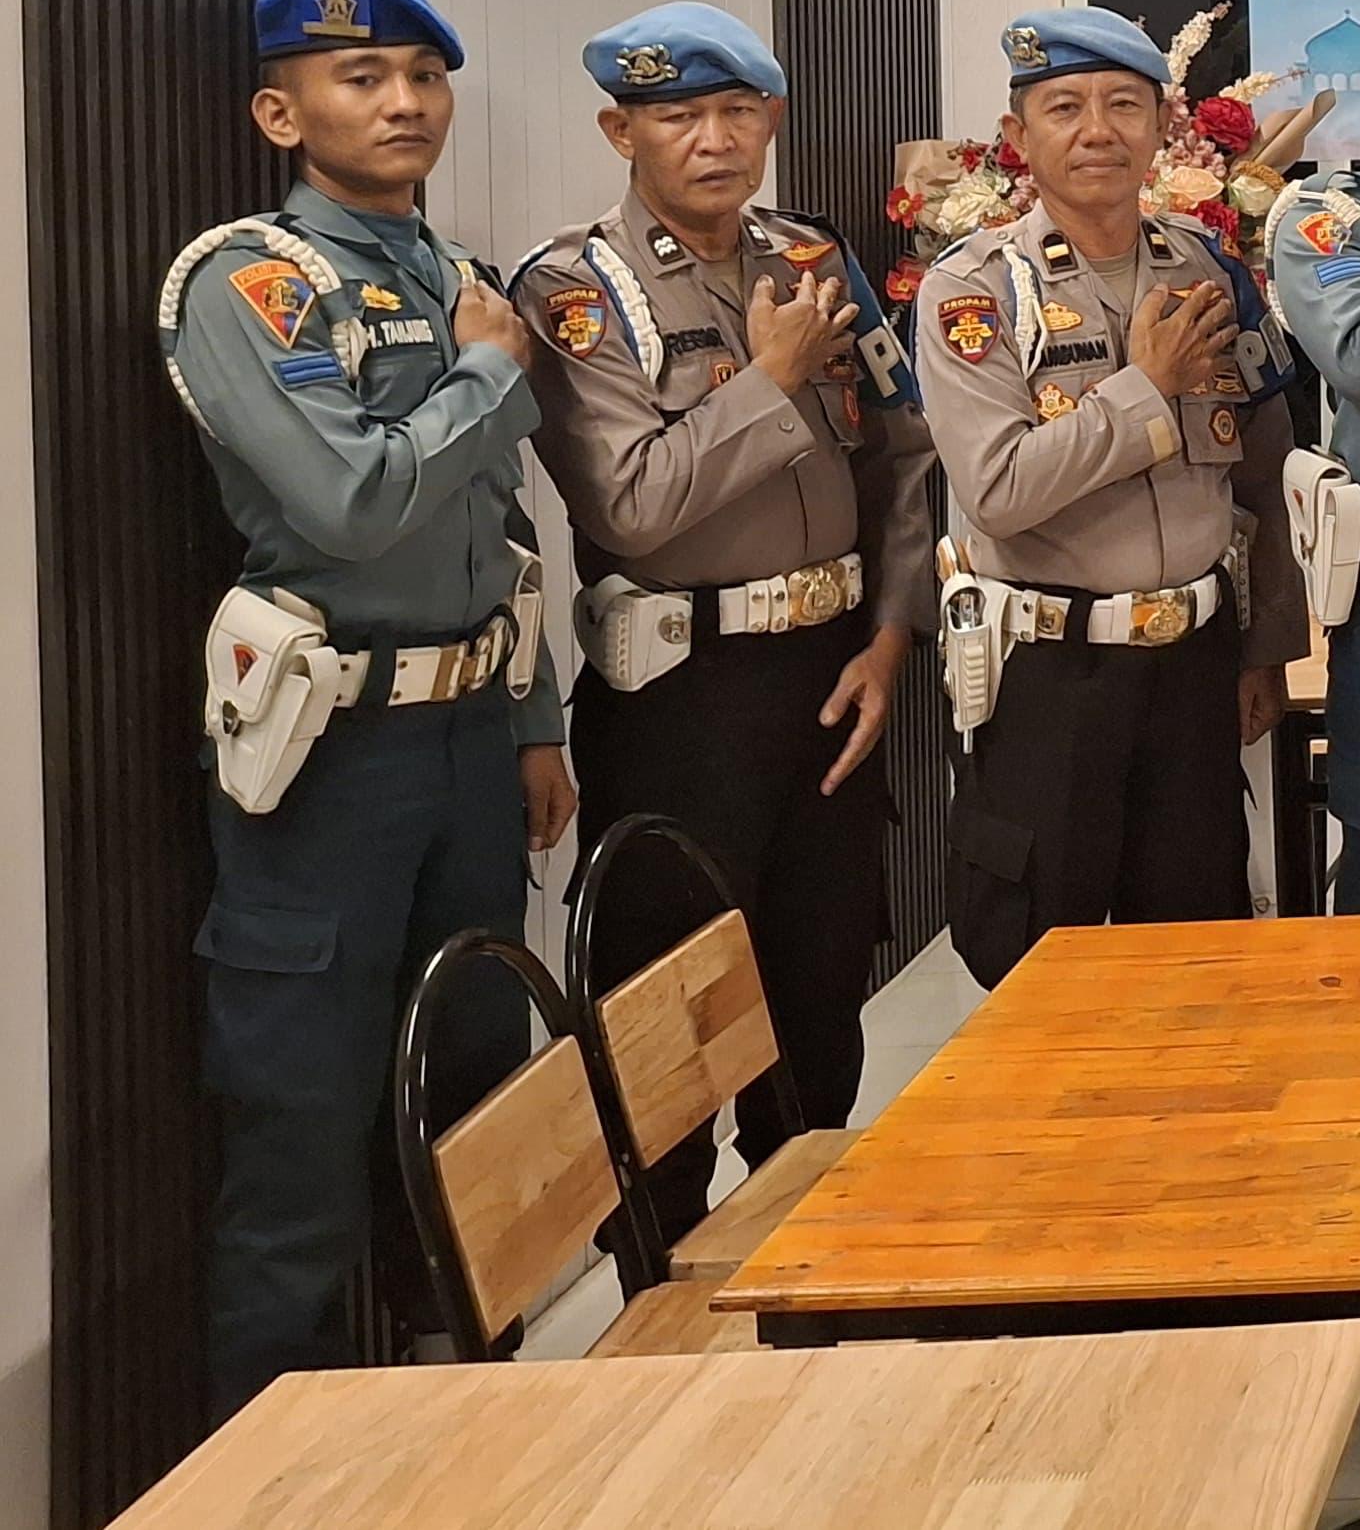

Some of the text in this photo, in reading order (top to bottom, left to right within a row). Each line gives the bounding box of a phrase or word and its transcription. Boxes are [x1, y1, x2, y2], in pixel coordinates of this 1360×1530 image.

[549, 289, 599, 306] PROPAM
[943, 297, 991, 311] PROPAM
[1040, 339, 1109, 368] AMBUNAN
